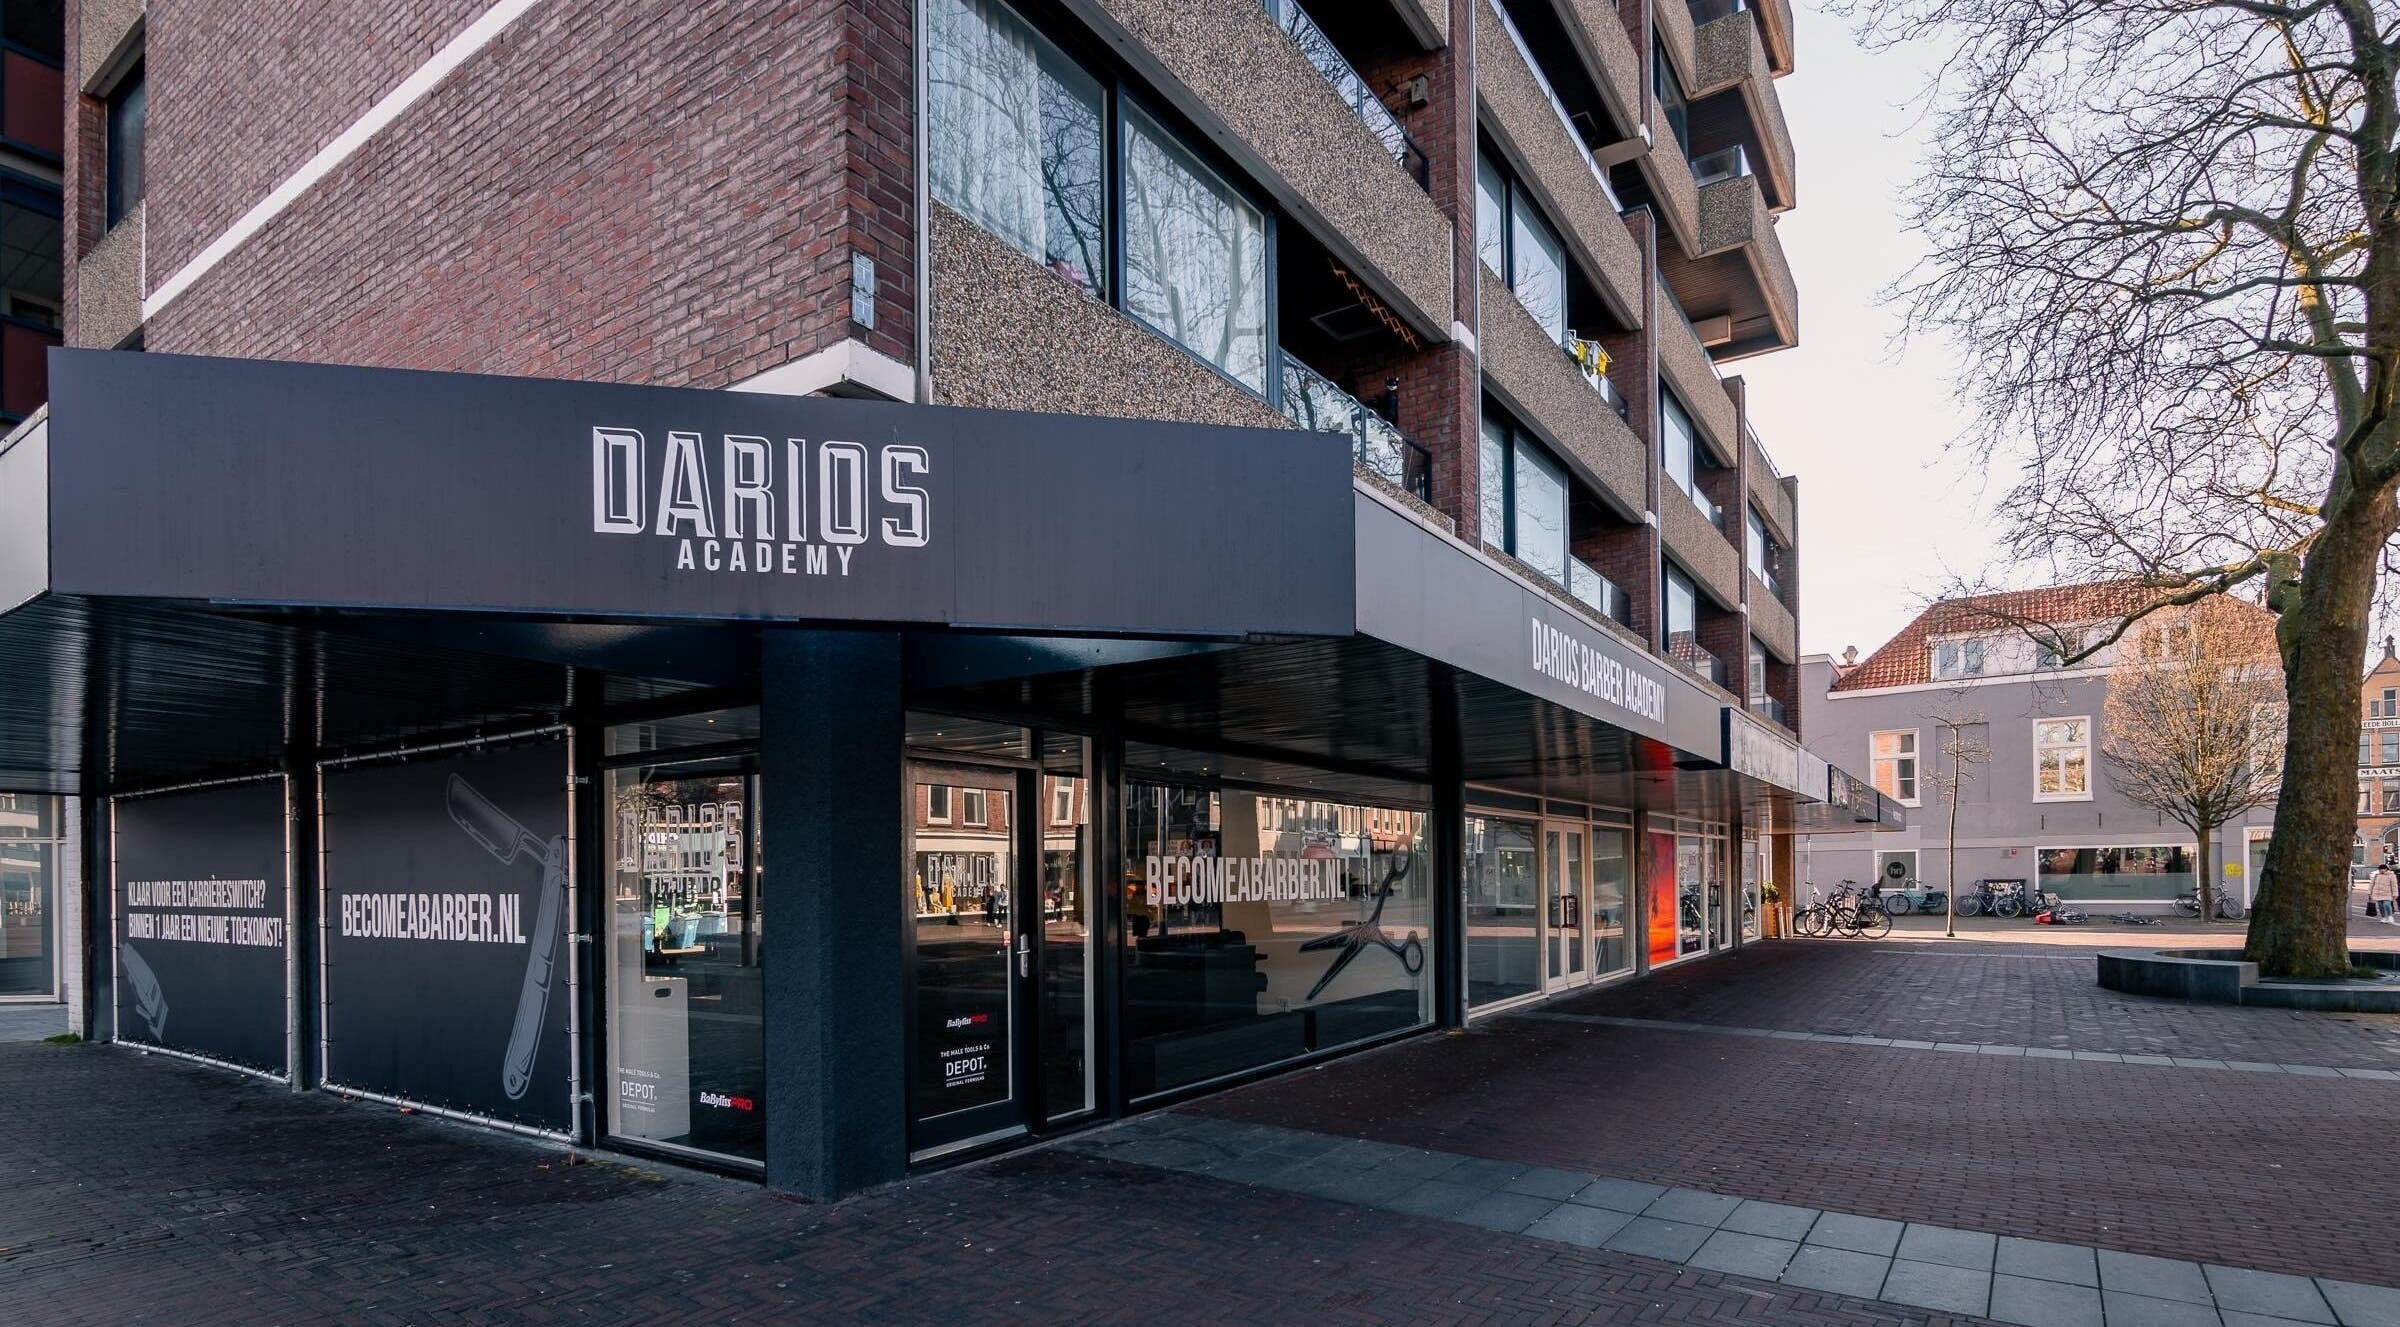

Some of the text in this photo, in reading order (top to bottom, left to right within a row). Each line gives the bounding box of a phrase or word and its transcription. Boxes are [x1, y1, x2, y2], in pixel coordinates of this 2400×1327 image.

[593, 426, 930, 547] DARIOS
[677, 539, 854, 576] ACADEMY
[1532, 617, 1665, 724] DARIOS BARBER ACADEMY
[128, 874, 266, 908] KLAAR VOOR EEN CARRIÈRESWITCH?
[1146, 855, 1345, 905] BECOMEABARBER.NL
[128, 913, 283, 947] BINNEN 1 JAAR EEN NIEUWE TOEKOMST!
[341, 893, 527, 944] BECOMEABARBER.NL
